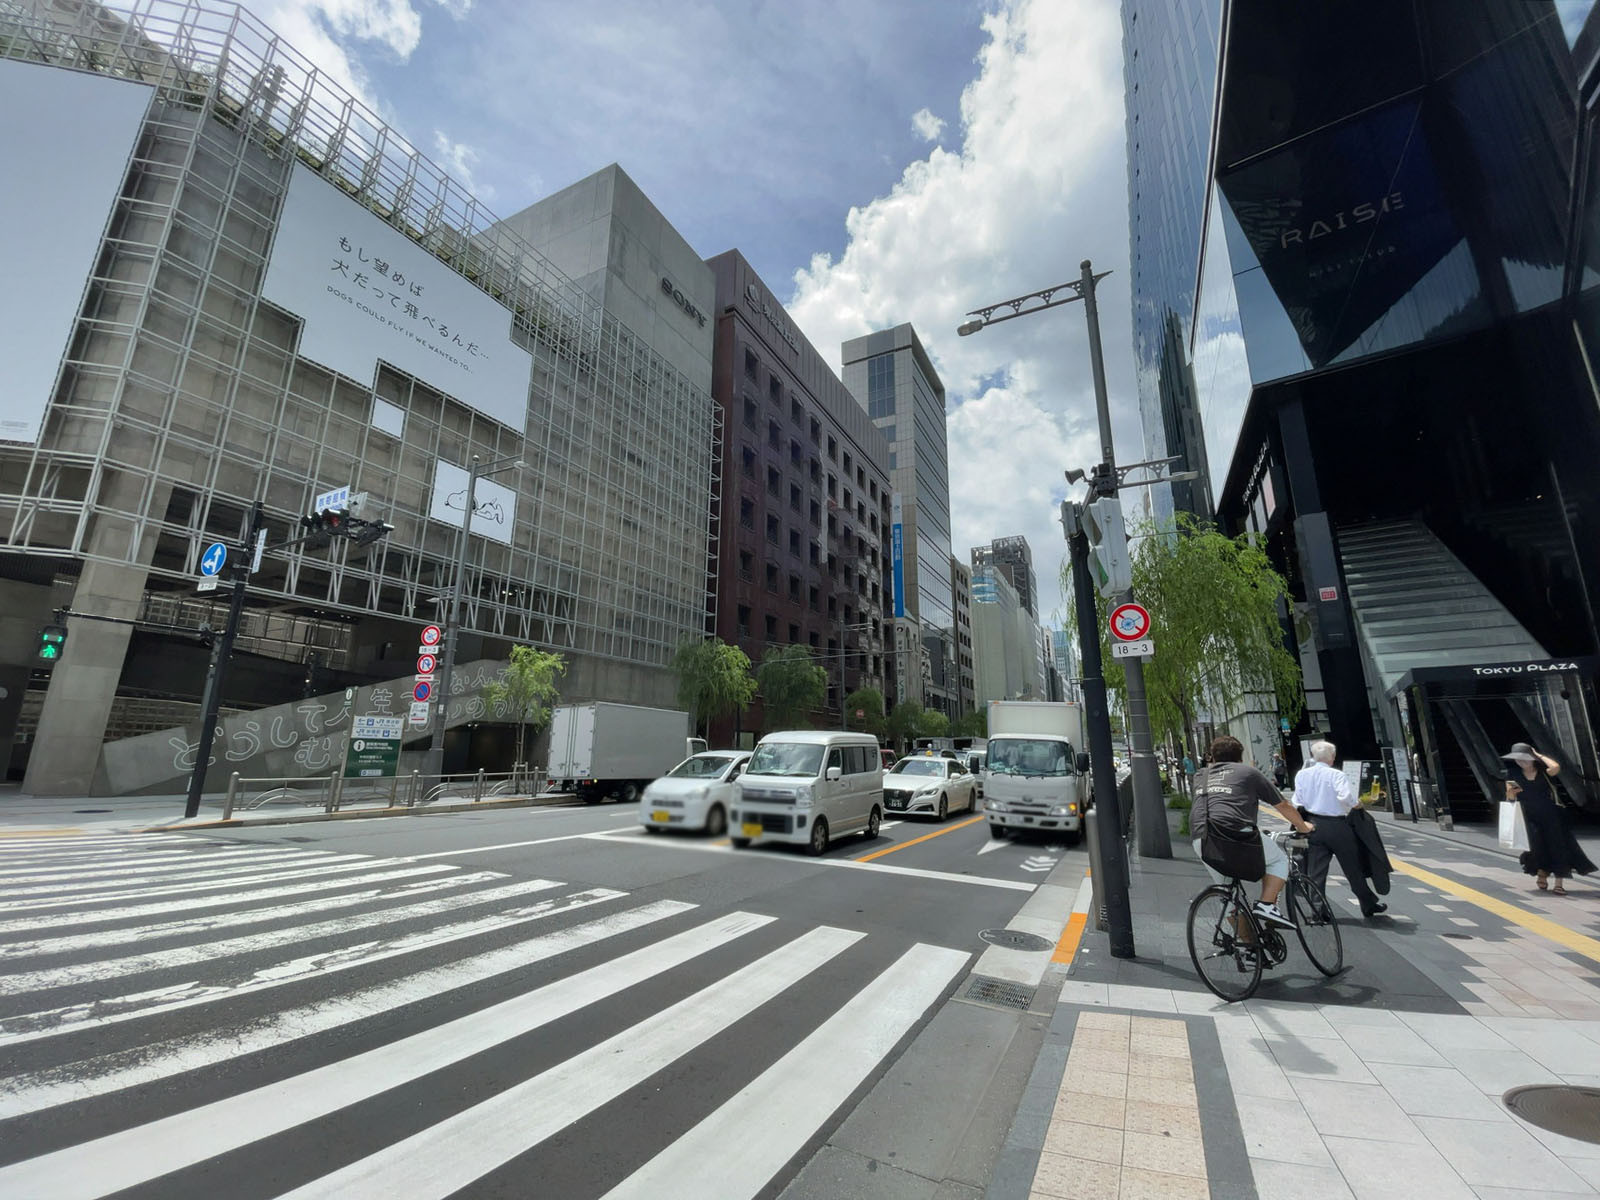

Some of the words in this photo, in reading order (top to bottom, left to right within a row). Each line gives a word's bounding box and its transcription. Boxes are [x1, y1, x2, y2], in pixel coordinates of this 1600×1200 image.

[1281, 192, 1405, 249] RAISE
[339, 236, 425, 297] もし望めば
[327, 285, 353, 304] DOGS
[356, 302, 386, 323] COULD
[388, 320, 404, 333] FLY
[405, 330, 415, 339] IF
[415, 336, 427, 347] WE
[428, 344, 459, 365] WANTED
[661, 277, 708, 328] SONY
[1473, 666, 1522, 675] TOKYU
[1527, 663, 1578, 672] PLAZA
